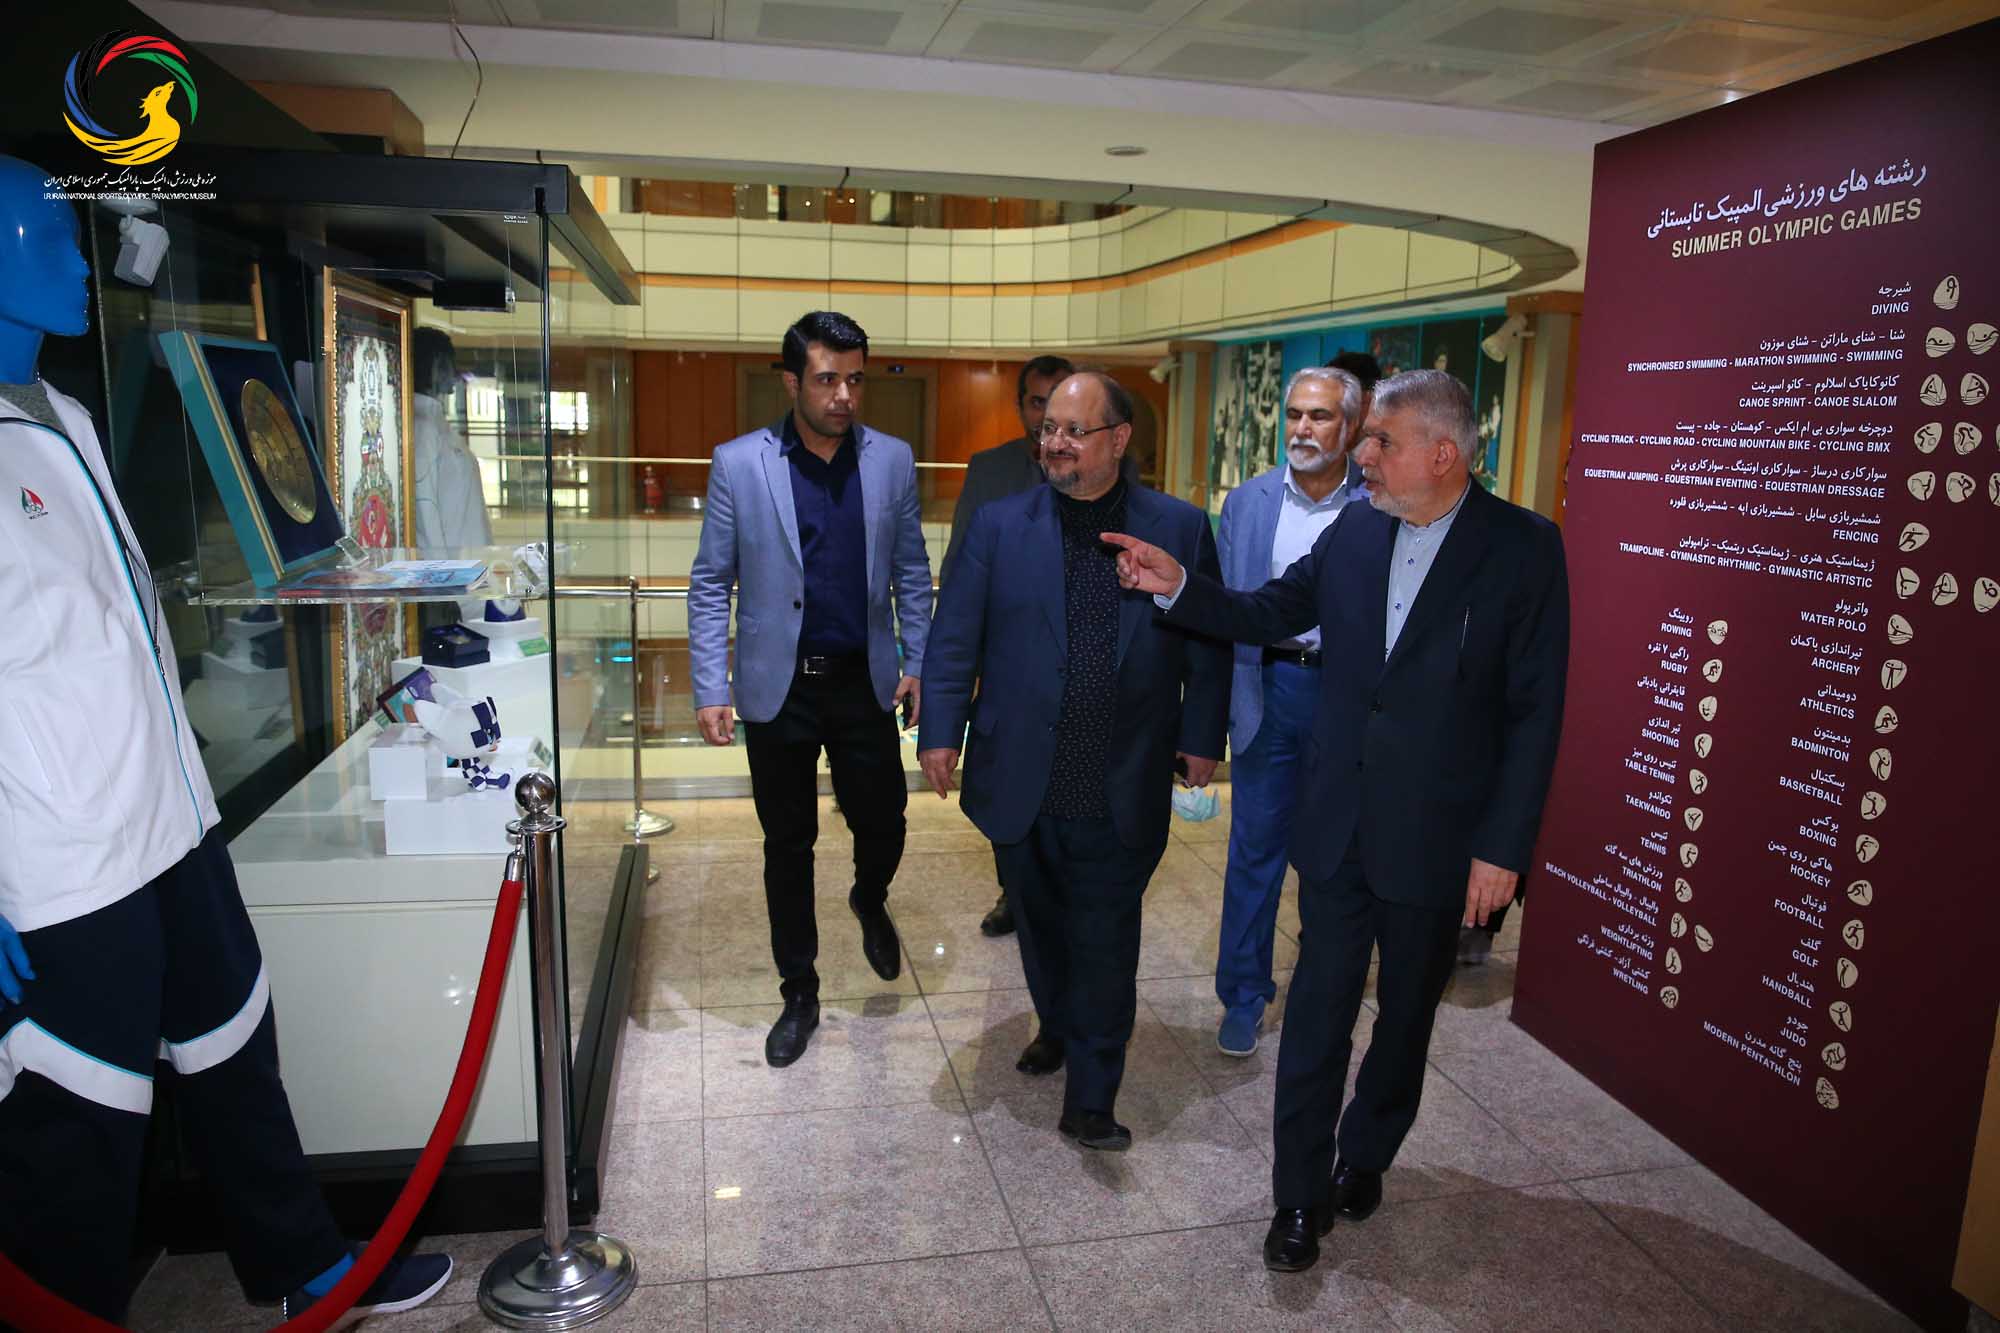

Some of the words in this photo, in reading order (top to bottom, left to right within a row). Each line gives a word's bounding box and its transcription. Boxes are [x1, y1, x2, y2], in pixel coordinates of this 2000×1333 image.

[1874, 158, 1926, 187] رشته
[1829, 168, 1868, 203] های
[1706, 188, 1762, 224] المپیک
[1764, 183, 1825, 217] ورزشی
[1647, 202, 1705, 239] تابستانی
[1671, 230, 1743, 258] SUMMER
[1748, 213, 1834, 246] OLYMPIC
[1840, 198, 1922, 231] GAMES
[1878, 281, 1912, 298] شیرجه
[1871, 302, 1909, 315] DIVING
[1787, 335, 1809, 350] شنای
[1820, 332, 1849, 348] ماراتن
[1851, 331, 1876, 346] شنای
[1889, 329, 1905, 340] شنا
[1760, 339, 1785, 351] موزون
[1627, 361, 1685, 372] SYNCHRONISED
[1686, 358, 1727, 370] SWIMMING
[1734, 355, 1785, 367] MARATHON
[1787, 353, 1837, 365] SWIMMING
[1846, 349, 1903, 362] SWIMMING
[1751, 378, 1785, 393] اسپرینت
[1786, 378, 1804, 393] کانو
[1814, 377, 1847, 394] اسلالوم
[1739, 398, 1770, 407] CANOE
[1772, 397, 1806, 407] SPRINT
[1814, 397, 1850, 407] CANOE
[1852, 396, 1898, 407] SLALOM
[1704, 420, 1721, 433] جاده
[1730, 420, 1765, 435] کوهستان
[1774, 421, 1799, 435] ایکس
[1825, 421, 1855, 436] سواری
[1581, 434, 1610, 443] CYCLING
[1611, 434, 1634, 444] TRACK
[1640, 435, 1671, 446] CYCLING
[1673, 436, 1695, 446] ROAD
[1701, 437, 1737, 448] CYCLING
[1739, 438, 1786, 449] MOUNTAIN
[1788, 440, 1811, 450] BIKE
[1819, 440, 1864, 452] CYCLING
[1866, 442, 1891, 453] BMX
[1811, 464, 1838, 478] درساژ
[1584, 468, 1626, 479] EQUESTRIAN
[1627, 472, 1659, 482] JUMPING
[1664, 474, 1714, 486] EQUESTRIAN
[1715, 477, 1758, 489] EVENTING
[1765, 481, 1825, 494] EQUESTRIAN
[1827, 485, 1886, 498] DRESSAGE
[1804, 508, 1827, 521] سابل
[1833, 529, 1879, 543] FENCING
[1619, 542, 1665, 557] TRAMPOLINE
[1670, 550, 1716, 565] GYMNASTIC
[1717, 557, 1761, 572] RHYTHMIC
[1768, 564, 1824, 581] GYMNASTIC
[1825, 573, 1873, 588] ARTISTIC
[1799, 553, 1823, 565] هنری
[1826, 554, 1876, 572] ژیمناستیک
[1661, 622, 1692, 638] ROWING
[1800, 611, 1835, 627] WATER
[1837, 618, 1867, 633] POLO
[1661, 660, 1688, 674] RUGBY
[1811, 657, 1861, 676] ARCHERY
[1654, 695, 1684, 712] SAILING
[1800, 697, 1855, 719] ATHLETICS
[1641, 728, 1680, 748] SHOOTING
[1791, 737, 1850, 762] BADMINTON
[1624, 758, 1648, 774] TABLE
[1649, 767, 1676, 784] TENNIS
[1779, 776, 1843, 806] BASKETBALL
[1625, 794, 1671, 820] TAEKWANDO
[1800, 825, 1837, 847] BOXING
[1640, 836, 1667, 856] TENNIS
[1622, 866, 1662, 892] TRIATHLON
[1790, 864, 1831, 888] HOCKEY
[1545, 862, 1566, 879] BEACH
[1567, 873, 1607, 901] VOLLEYBALL
[1612, 896, 1657, 927] VOLLEYBALL
[1774, 899, 1824, 929] FOOTBALL
[1601, 924, 1653, 961] WEIGHTLIFTING
[1792, 949, 1820, 968] GOLF
[1762, 975, 1812, 1009] HANDBALL
[1780, 1027, 1807, 1048] JUDO
[1703, 1021, 1740, 1049] MODERN
[1740, 1043, 1801, 1086] PENTATHLON
